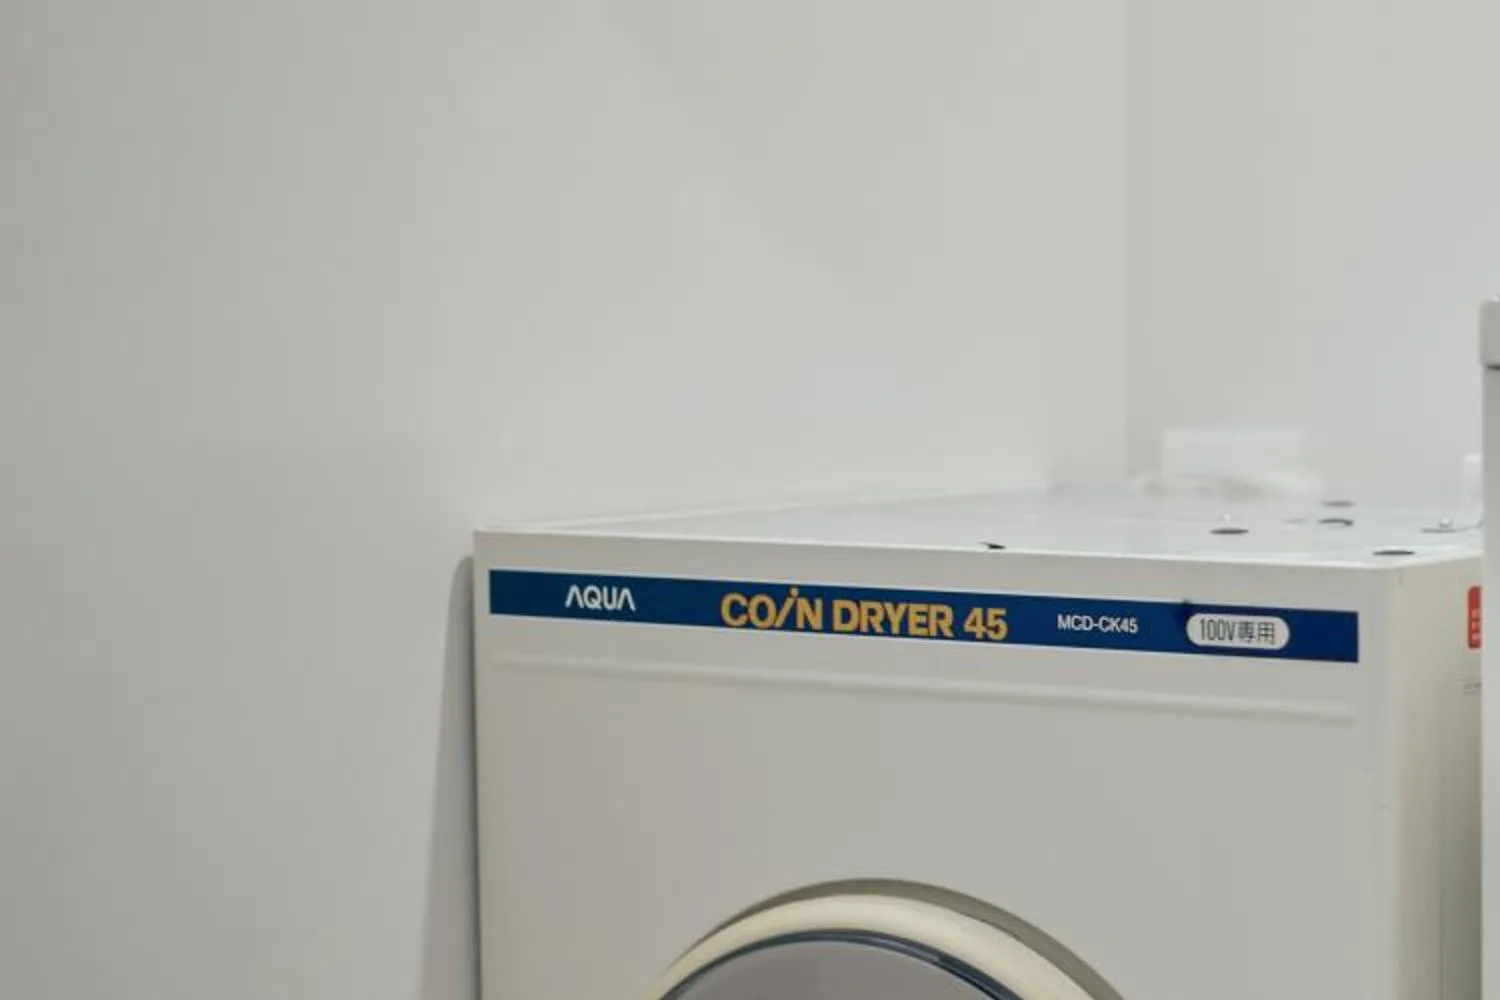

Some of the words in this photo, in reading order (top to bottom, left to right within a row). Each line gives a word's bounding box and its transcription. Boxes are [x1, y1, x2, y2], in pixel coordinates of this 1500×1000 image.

[564, 583, 637, 612] AQUA
[831, 599, 954, 638] DRYER
[963, 607, 1008, 641] 45
[1057, 613, 1139, 634] MCD-CK45
[1200, 618, 1276, 646] 100V専用
